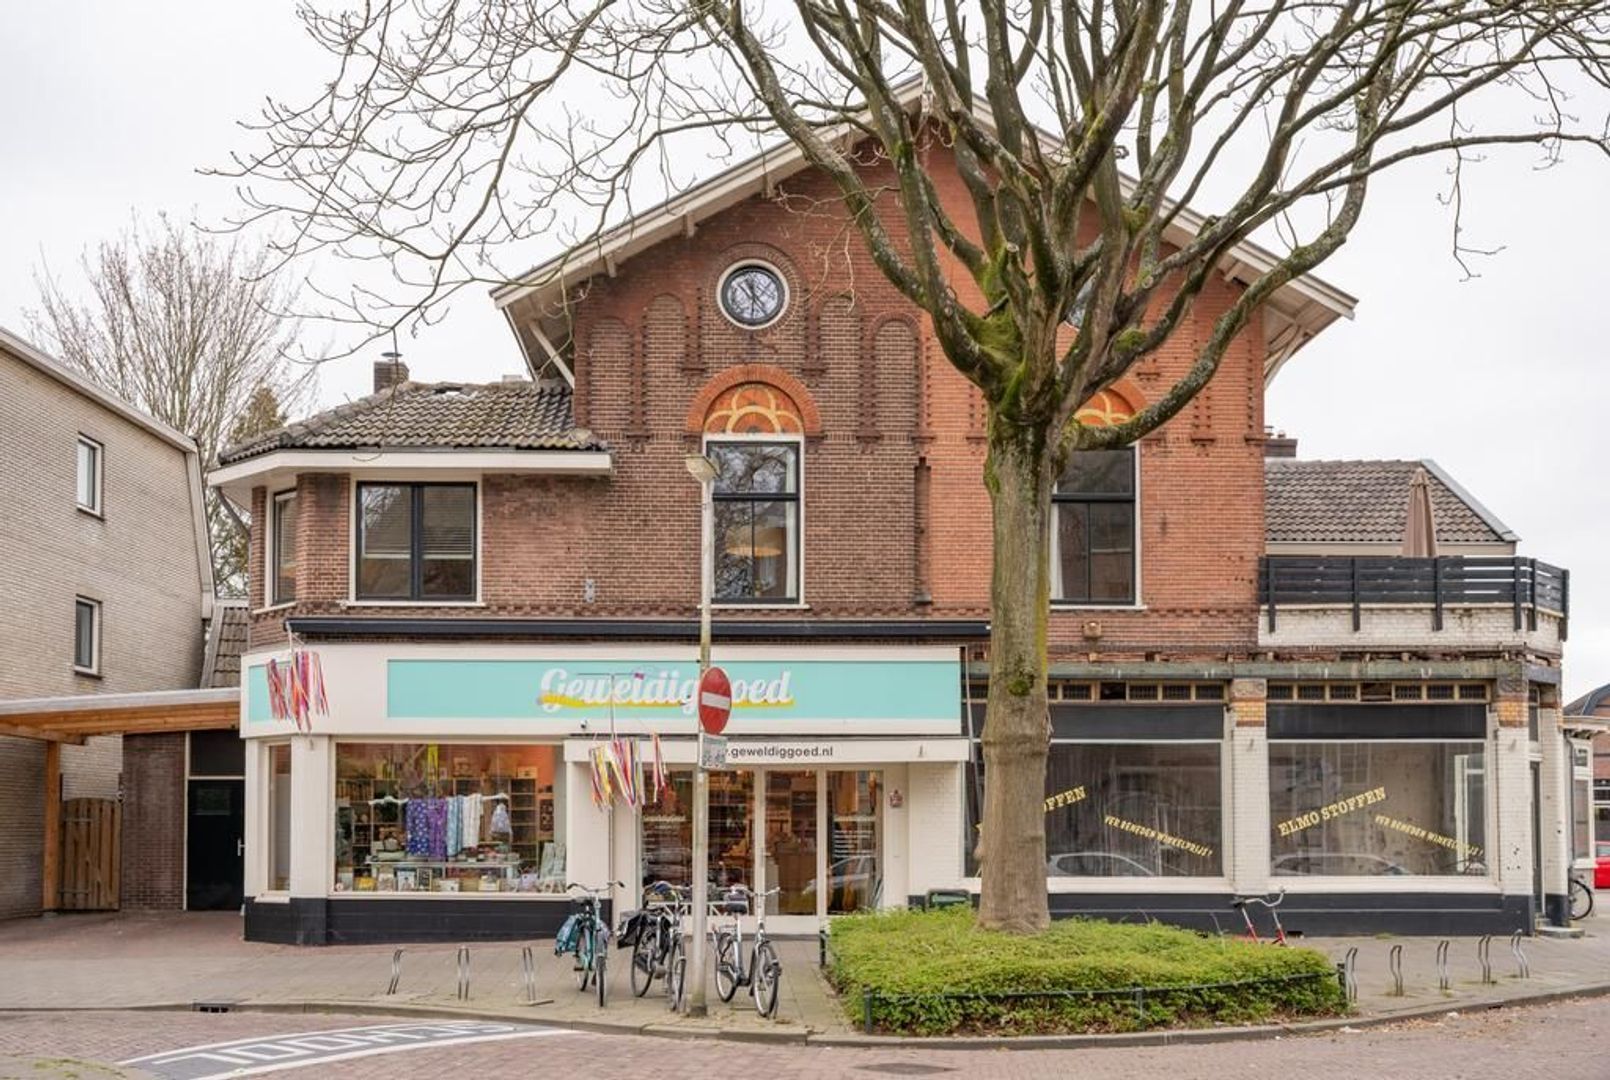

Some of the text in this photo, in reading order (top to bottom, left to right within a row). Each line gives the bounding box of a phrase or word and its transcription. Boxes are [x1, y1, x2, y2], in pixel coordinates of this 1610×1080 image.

[538, 668, 793, 714] Geweldigoed
[725, 746, 833, 758] .geweldiggoed.nl
[1044, 785, 1086, 812] FFEN
[1278, 786, 1386, 837] ELMO STOFFEN
